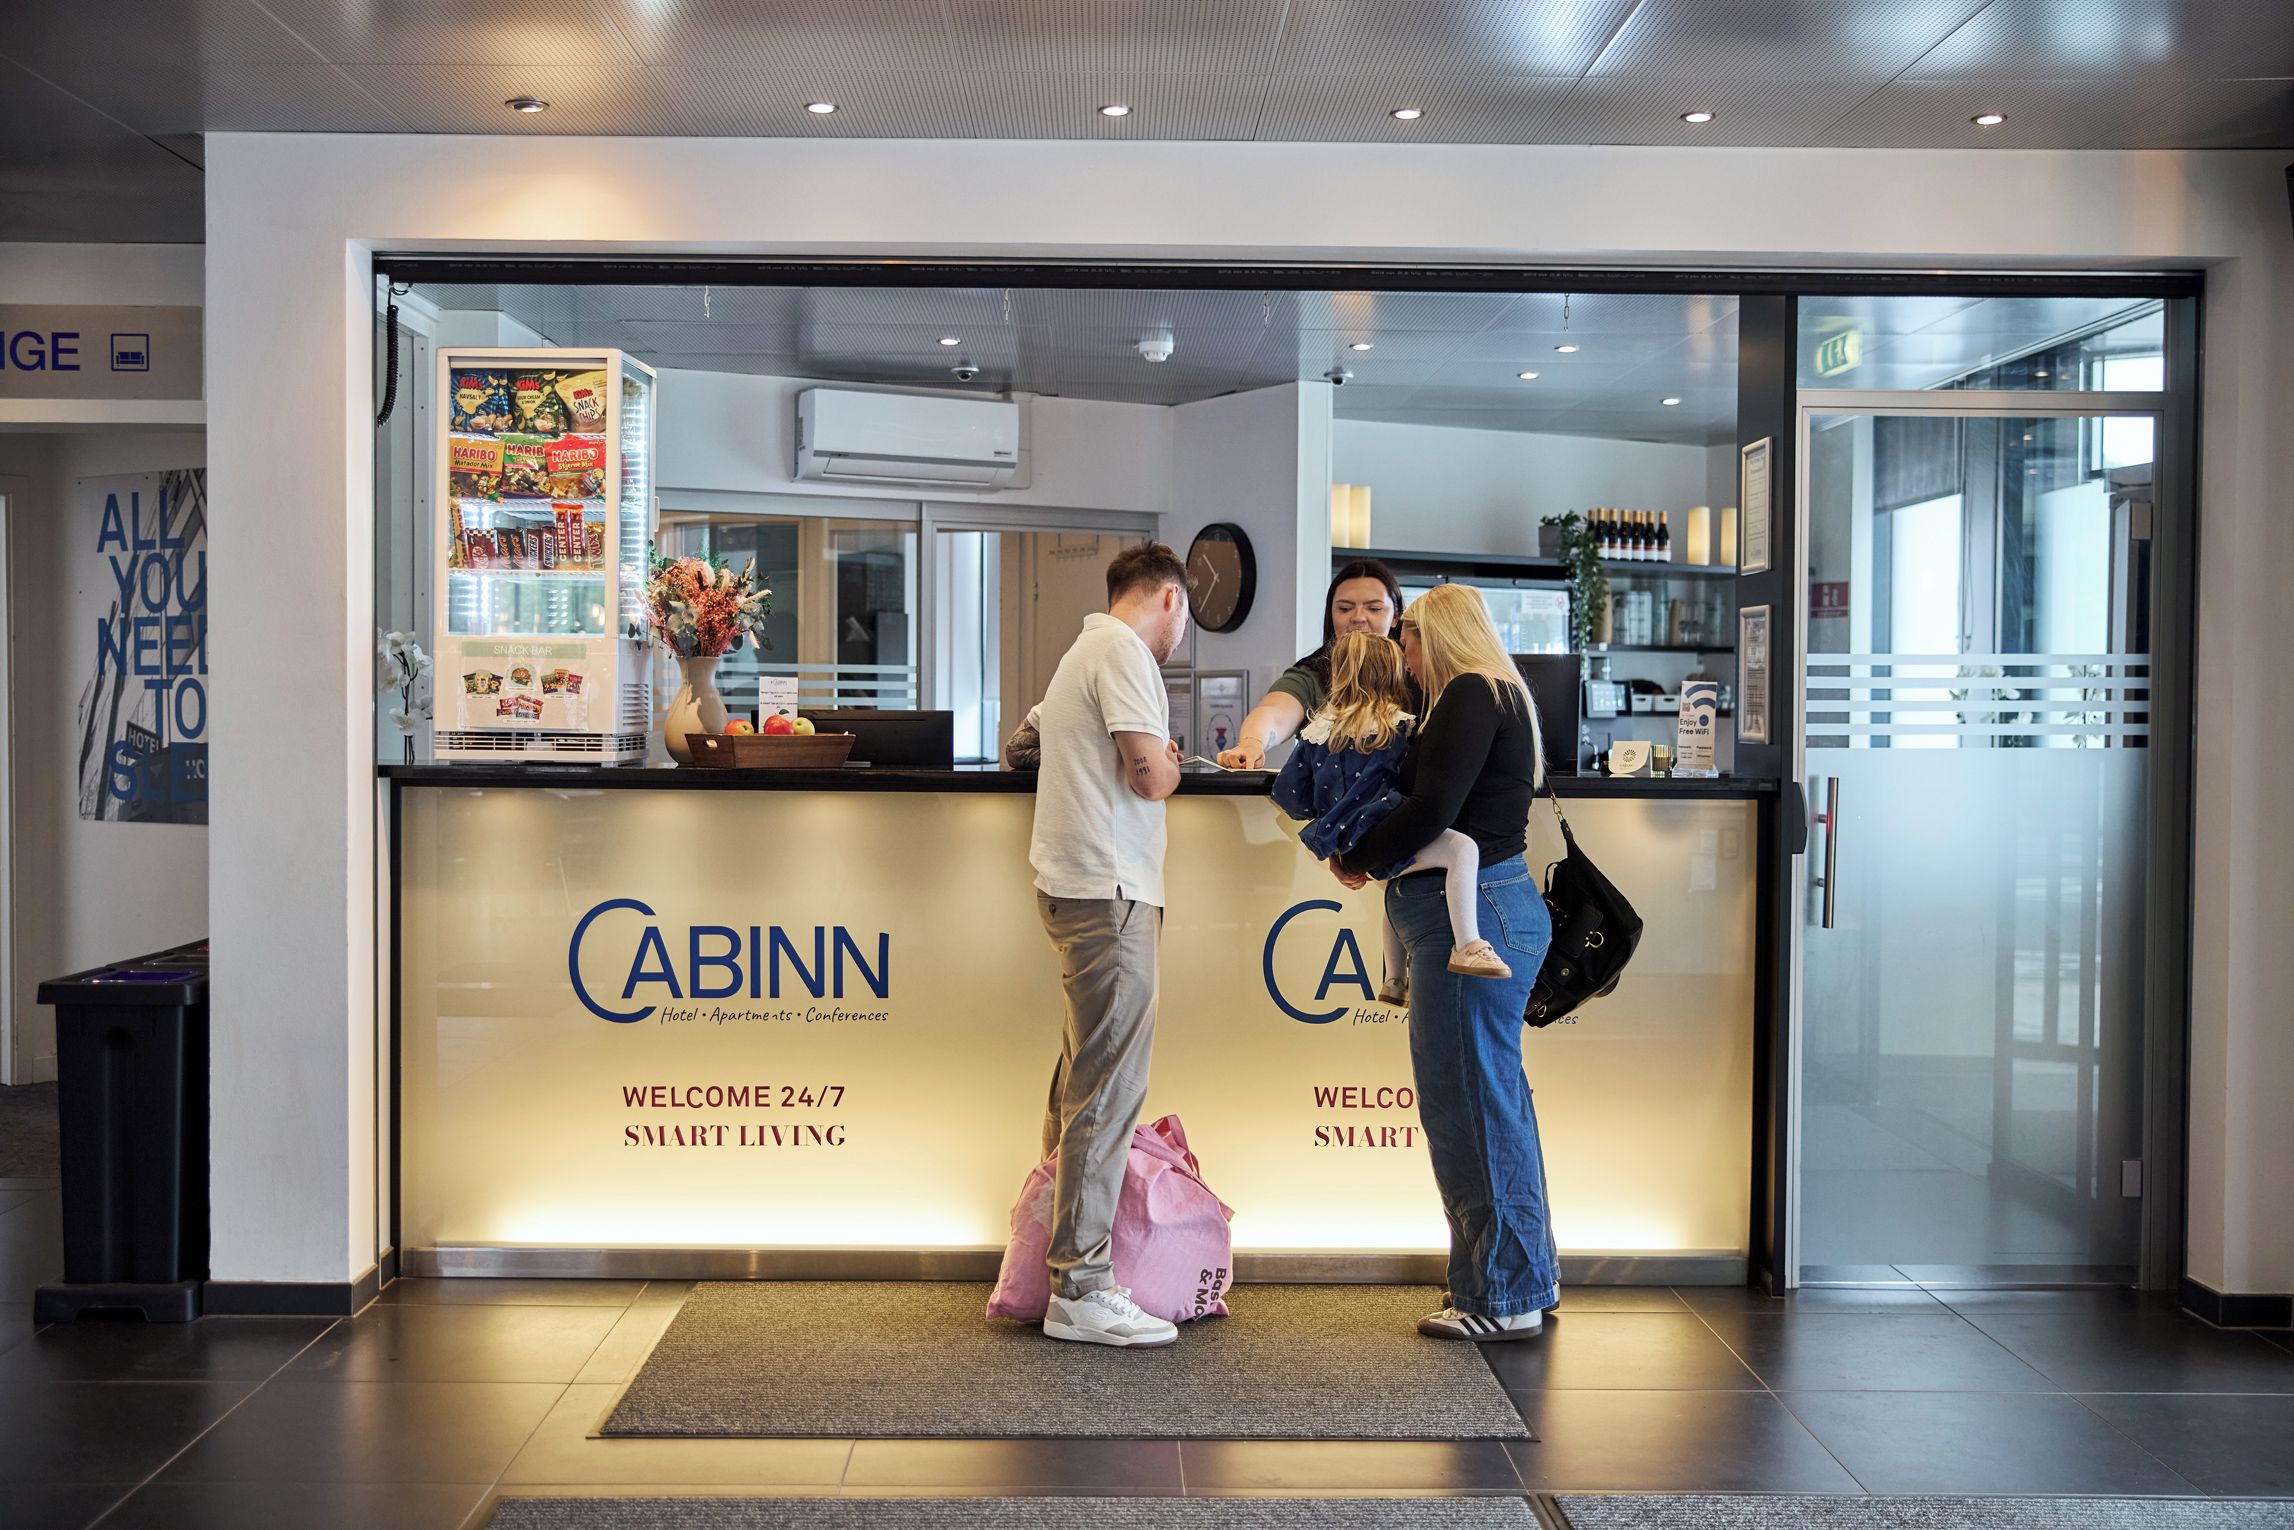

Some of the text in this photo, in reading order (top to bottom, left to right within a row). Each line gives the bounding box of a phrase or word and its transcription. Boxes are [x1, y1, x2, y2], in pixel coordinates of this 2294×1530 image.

[0, 331, 80, 371] GE
[573, 397, 599, 414] SNACK
[579, 408, 601, 422] CHIPS
[453, 446, 497, 462] HARIBO
[506, 444, 547, 458] HARIB
[552, 448, 599, 463] HARIBO
[455, 459, 480, 467] Matador
[558, 461, 581, 471] Stjerne
[97, 489, 185, 553] ALL
[557, 522, 567, 562] CENTER
[572, 522, 582, 562] CENTER
[109, 551, 207, 613] YOU
[494, 646, 553, 655] SNACK BAR
[144, 678, 207, 739] TO
[1679, 719, 1697, 727] Enjoy
[568, 898, 890, 1024] CABINN
[660, 1006, 889, 1026] Hotel Apartments Conferences
[1353, 1007, 1390, 1026] Hotel
[622, 1085, 845, 1109] WELCOME 24/7
[1313, 1086, 1420, 1109] WELCO
[624, 1124, 846, 1147] SMART LIVING
[1314, 1126, 1419, 1148] SMART
[1200, 1268, 1213, 1285] &
[1209, 1267, 1227, 1306] Bas
